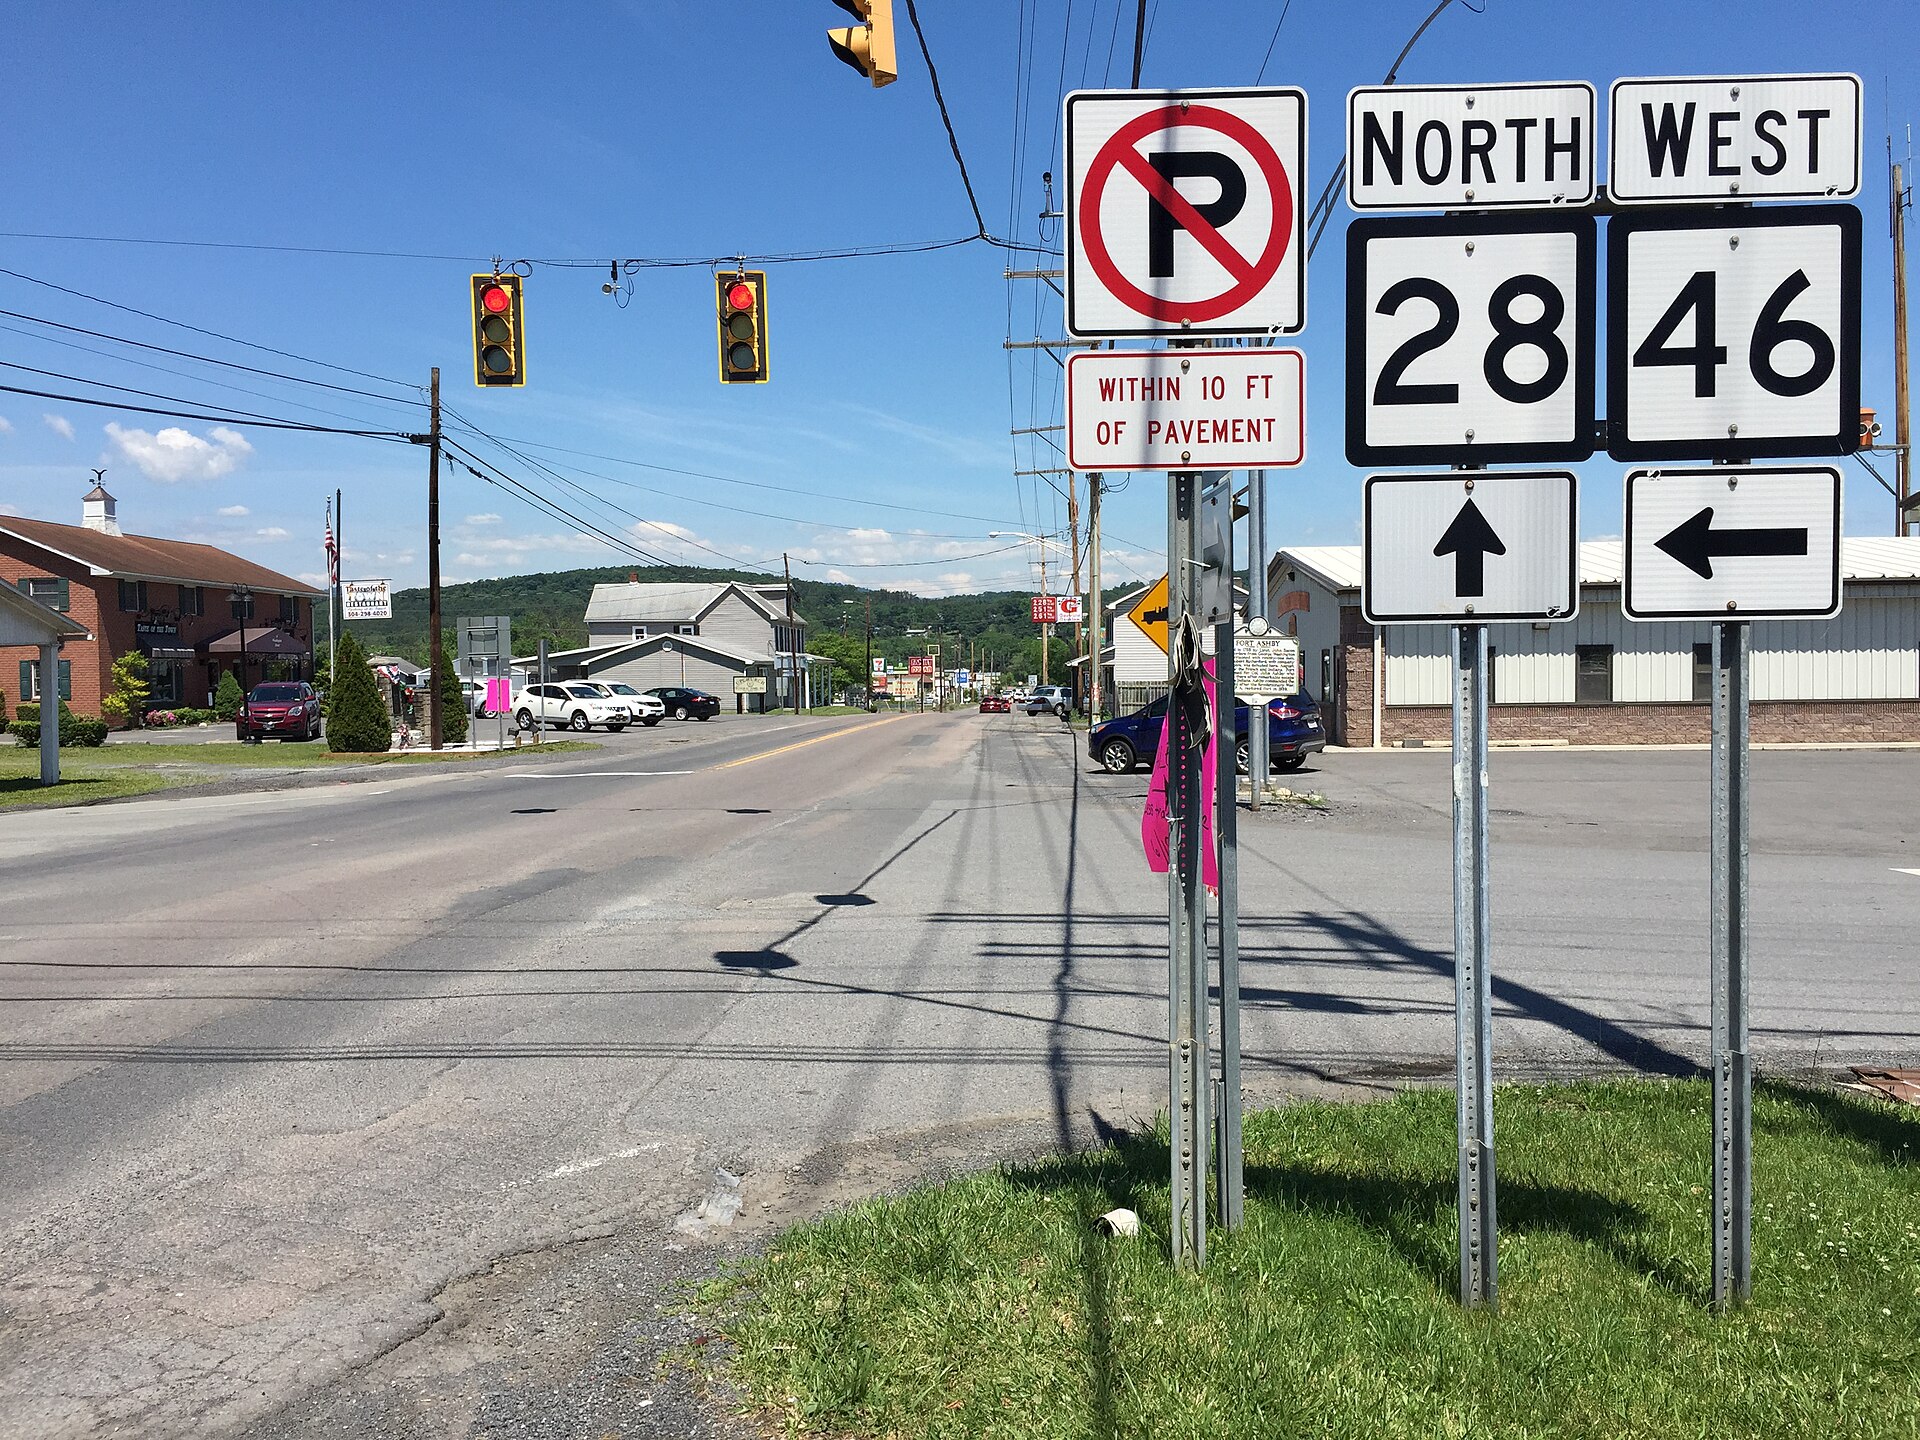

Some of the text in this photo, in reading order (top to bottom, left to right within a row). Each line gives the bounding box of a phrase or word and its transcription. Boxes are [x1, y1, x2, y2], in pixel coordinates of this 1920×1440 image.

[1362, 110, 1581, 187] NORTH
[1640, 101, 1831, 178] WEST
[1148, 151, 1247, 278] P
[1373, 273, 1569, 406] 28
[1632, 267, 1836, 399] 46
[1098, 374, 1273, 402] WITHIN 10 FT
[1096, 417, 1276, 446] OF PAVEMENT
